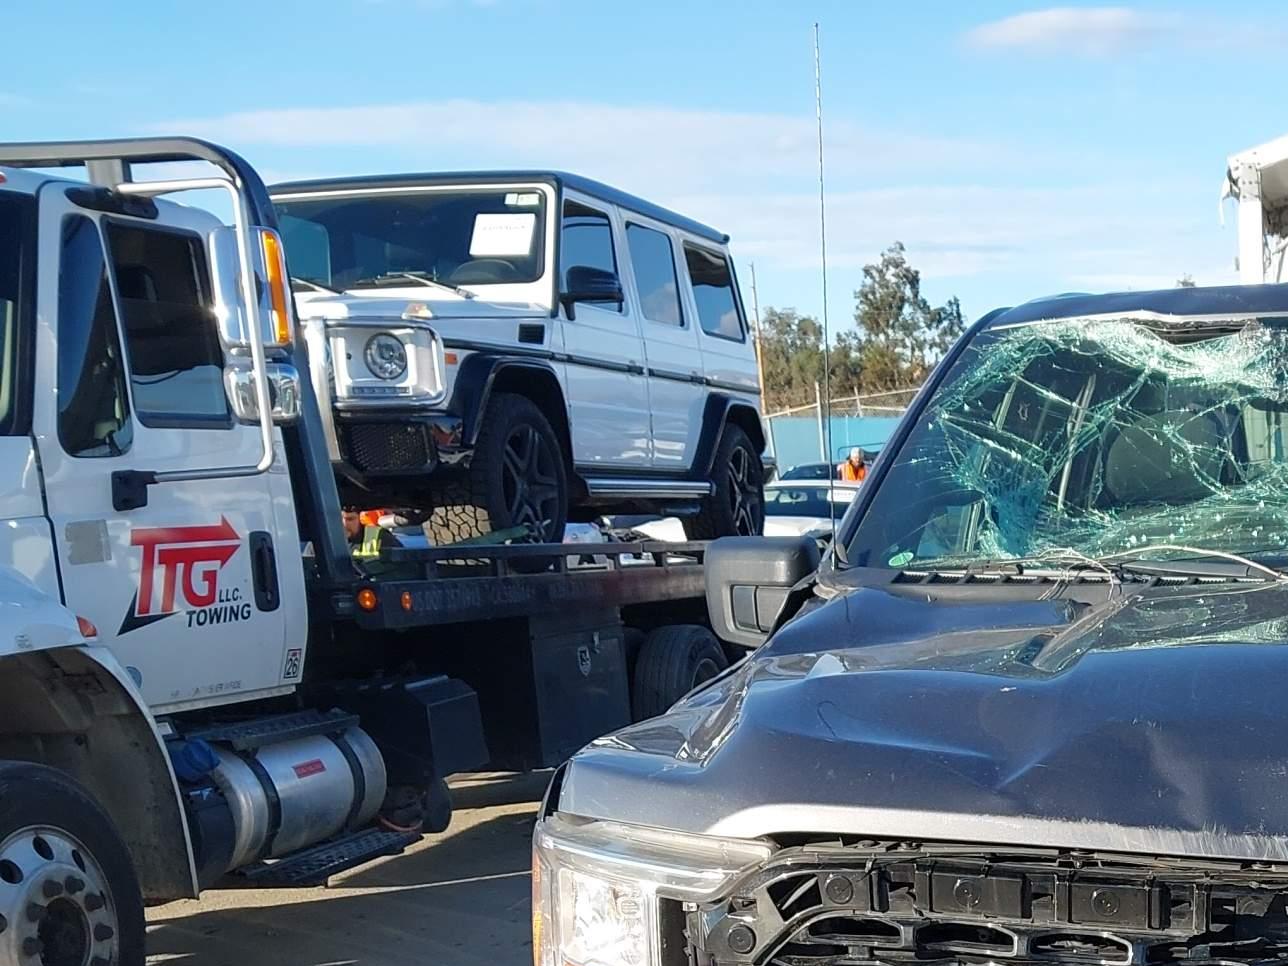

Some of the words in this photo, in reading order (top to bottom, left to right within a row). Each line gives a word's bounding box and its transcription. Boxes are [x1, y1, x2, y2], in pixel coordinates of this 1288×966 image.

[130, 515, 241, 615] TTG
[219, 588, 242, 603] LLC.
[186, 603, 251, 628] TOWING
[286, 657, 298, 675] 26
